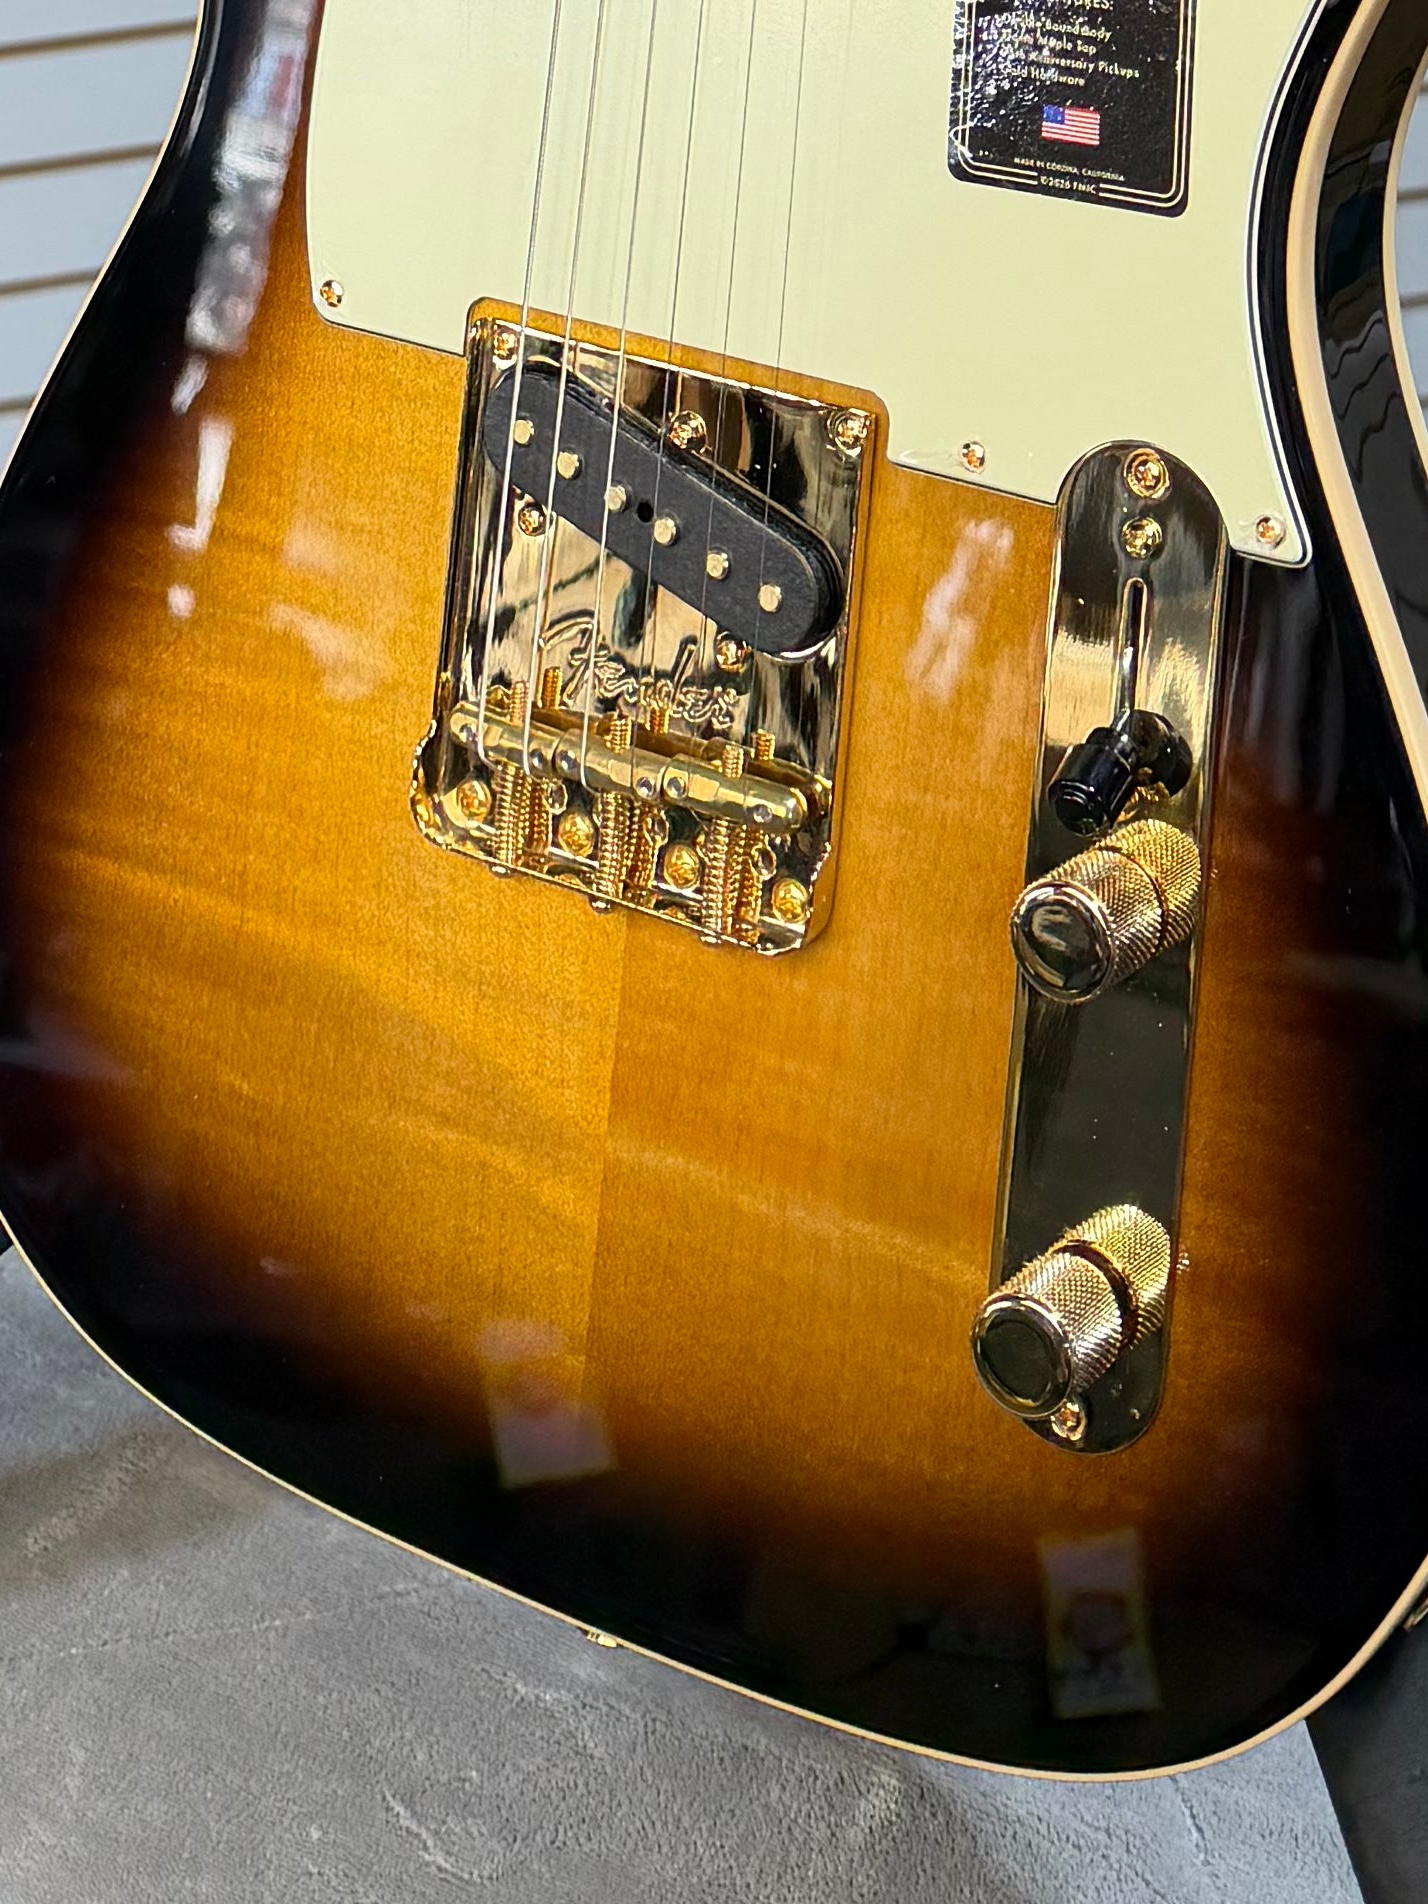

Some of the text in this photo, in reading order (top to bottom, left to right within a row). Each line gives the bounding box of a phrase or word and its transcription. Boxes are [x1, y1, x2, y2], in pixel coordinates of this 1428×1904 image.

[1077, 40, 1097, 55] Top
[1030, 66, 1086, 87] Hardware
[1098, 61, 1140, 79] Pickups
